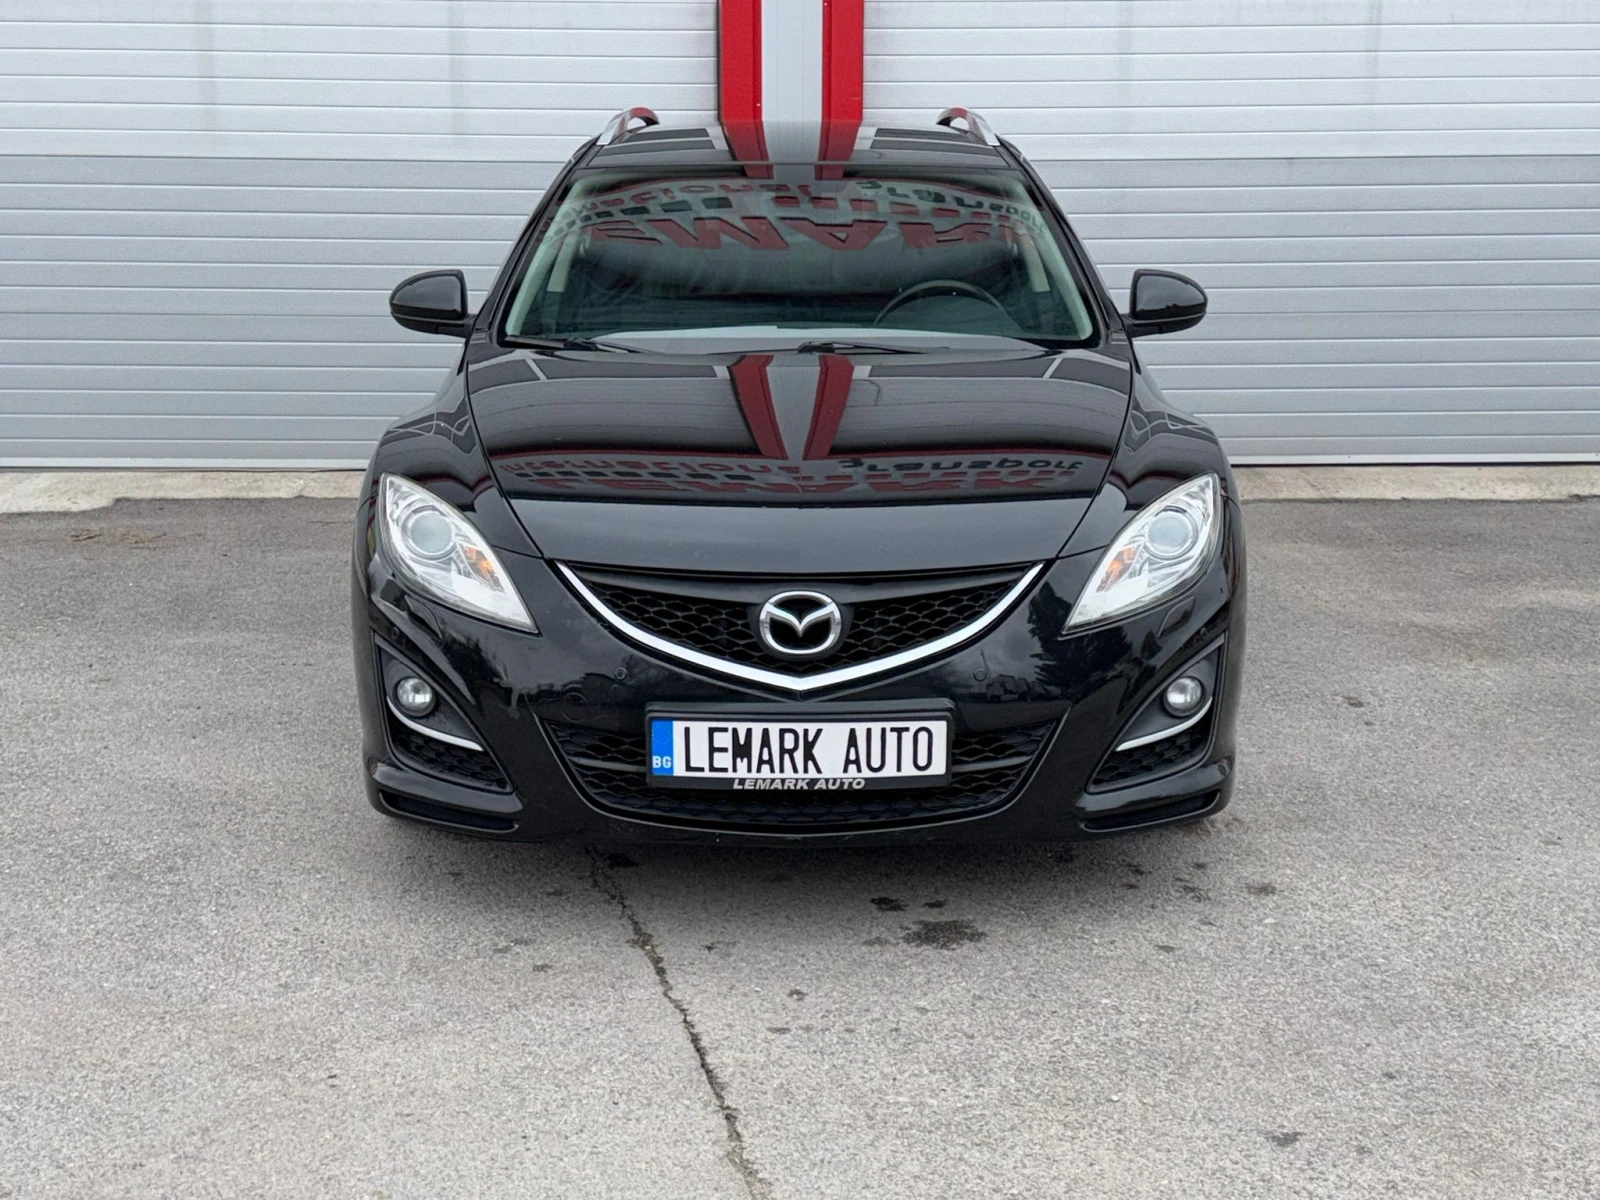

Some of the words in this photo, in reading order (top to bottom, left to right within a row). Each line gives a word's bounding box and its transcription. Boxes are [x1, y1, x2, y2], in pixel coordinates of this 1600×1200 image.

[684, 726, 823, 774] LEMARK
[843, 726, 933, 773] AUTO
[652, 755, 672, 769] BG
[733, 778, 809, 790] LEMARK
[814, 778, 866, 790] AUTO
